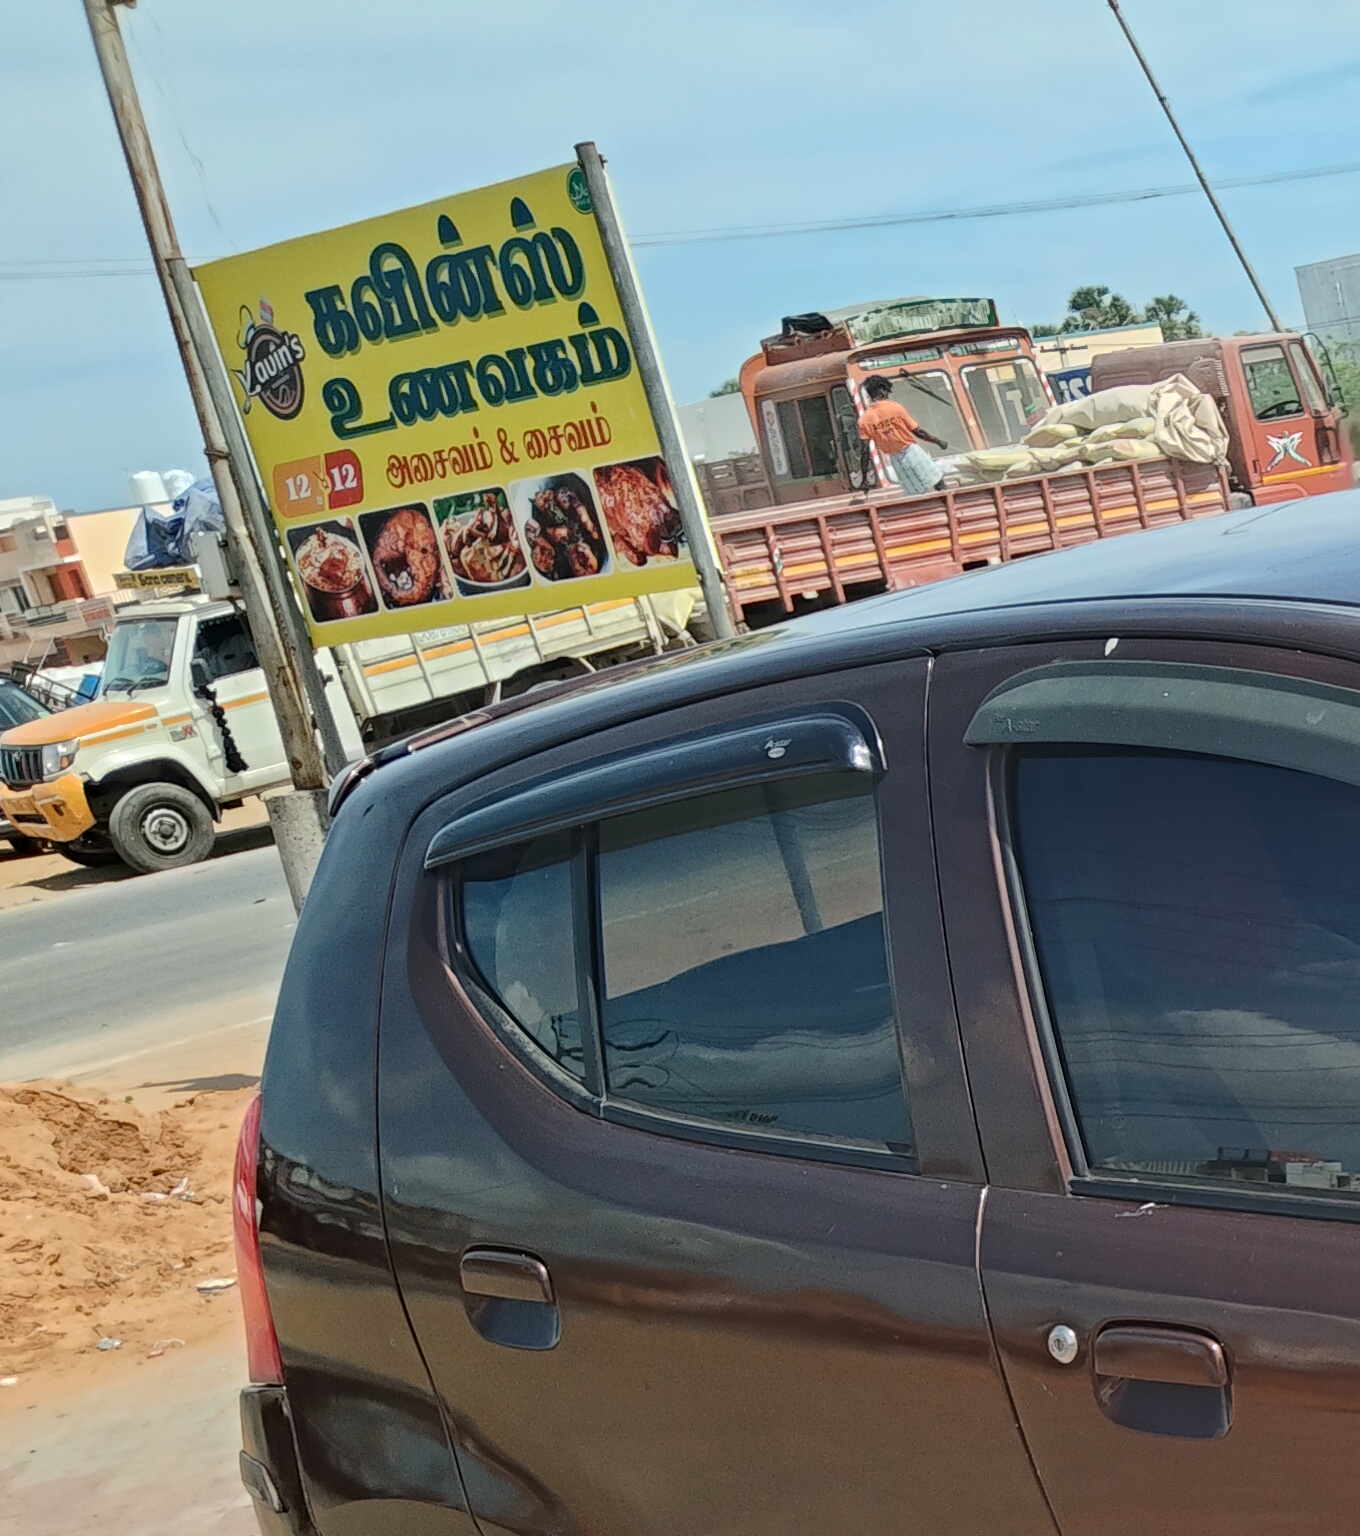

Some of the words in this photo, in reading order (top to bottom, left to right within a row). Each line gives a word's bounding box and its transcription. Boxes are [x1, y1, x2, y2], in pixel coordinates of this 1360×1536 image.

[304, 196, 586, 358] கவின்ஸ்
[322, 301, 632, 441] உணவகம்
[285, 473, 312, 501] 12
[330, 463, 358, 492] 12
[386, 426, 493, 488] அசைவம்
[497, 427, 520, 466] &
[523, 401, 612, 456] சைவம்
